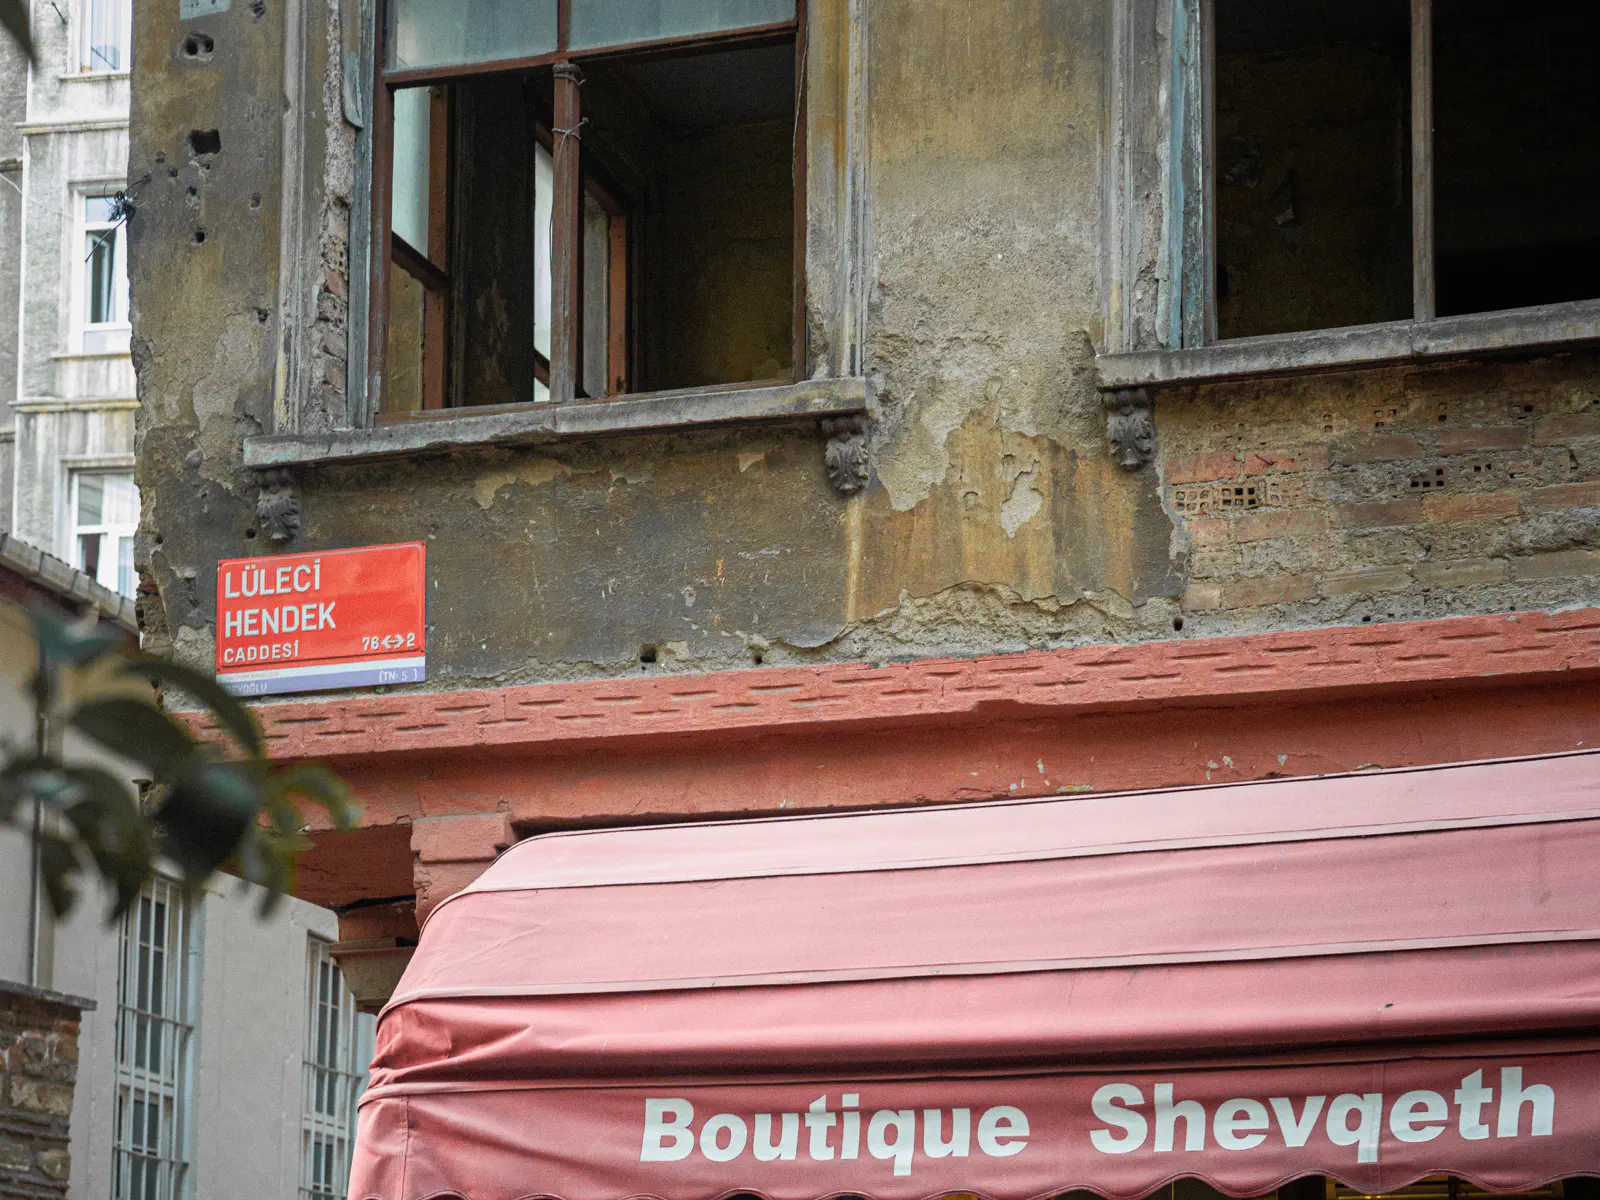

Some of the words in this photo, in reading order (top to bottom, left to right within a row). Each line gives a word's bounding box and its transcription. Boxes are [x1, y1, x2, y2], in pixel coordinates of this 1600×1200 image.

[224, 558, 321, 599] LÜLECİ
[225, 601, 337, 638] HENDEK
[223, 639, 299, 663] CADDESİ
[640, 1092, 1031, 1177] Boutique
[1089, 1066, 1556, 1164] Shevqeth
